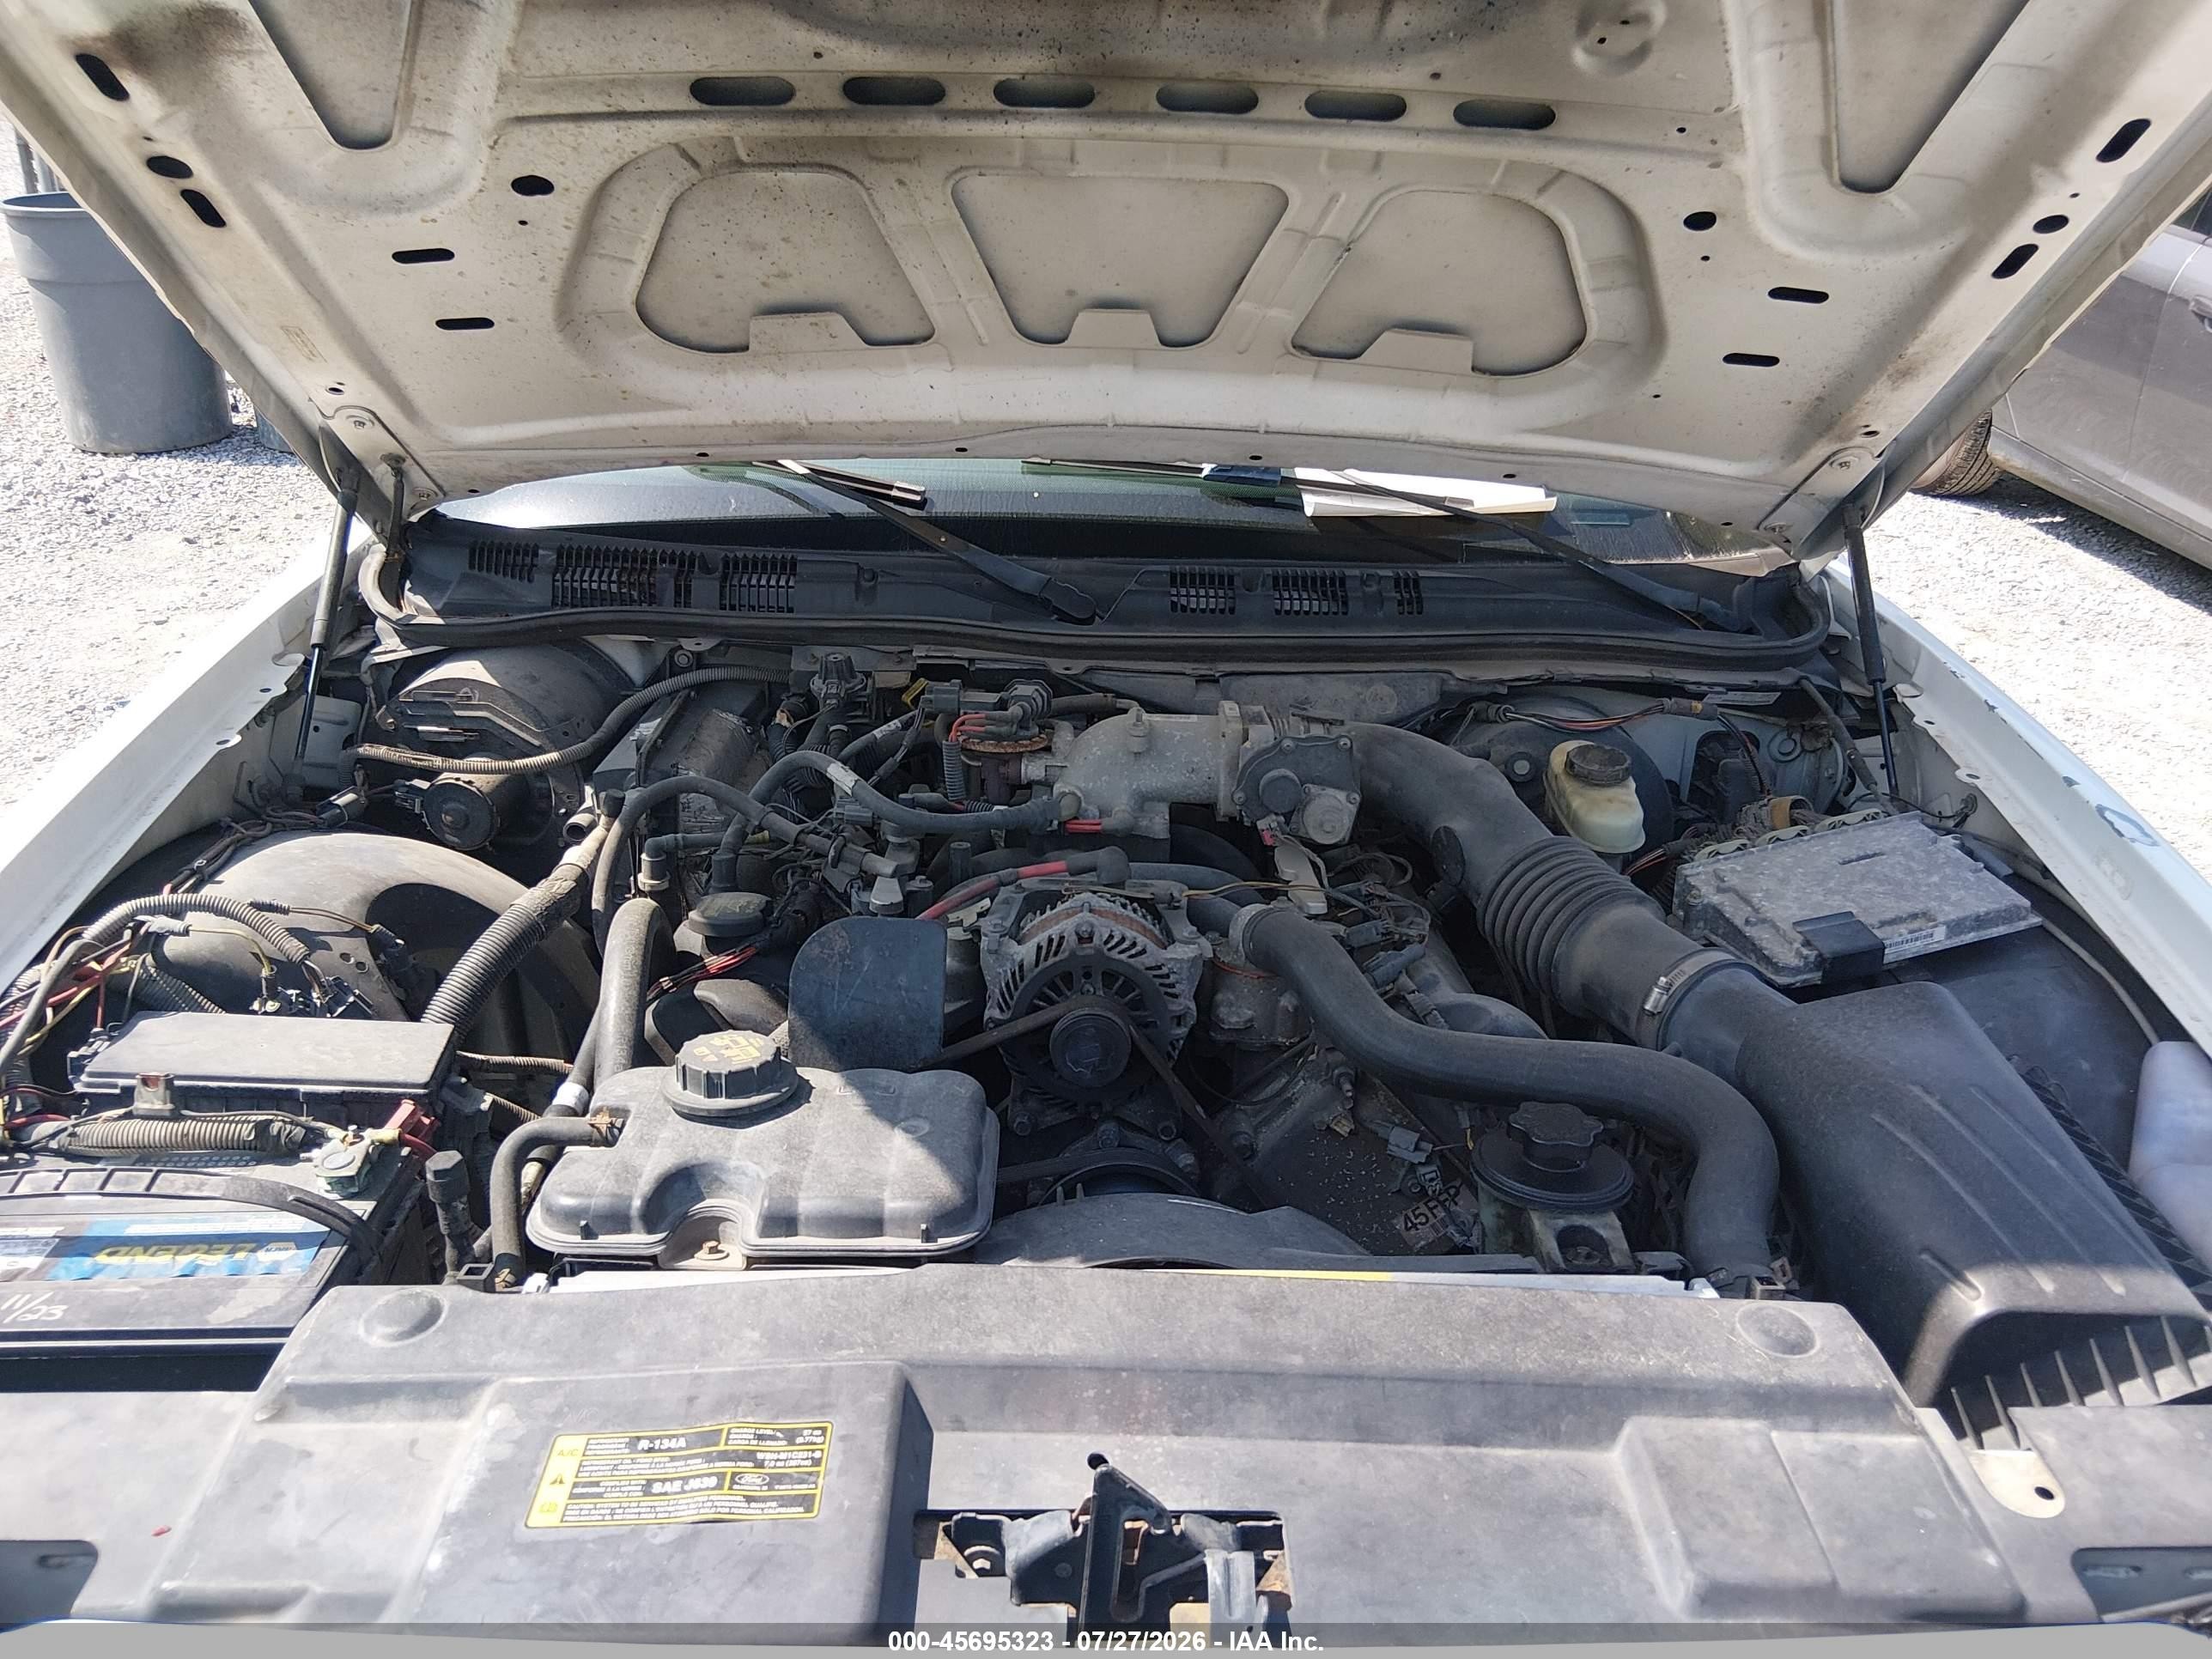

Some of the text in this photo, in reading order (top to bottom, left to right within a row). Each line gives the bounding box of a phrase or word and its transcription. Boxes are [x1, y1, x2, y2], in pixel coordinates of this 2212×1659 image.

[93, 1243, 258, 1264] LEGEND
[0, 1291, 69, 1323] 11/23
[557, 1449, 579, 1457] A/C
[637, 1437, 687, 1451] R-134A
[652, 1480, 683, 1493] SAE
[684, 1475, 718, 1491] J639
